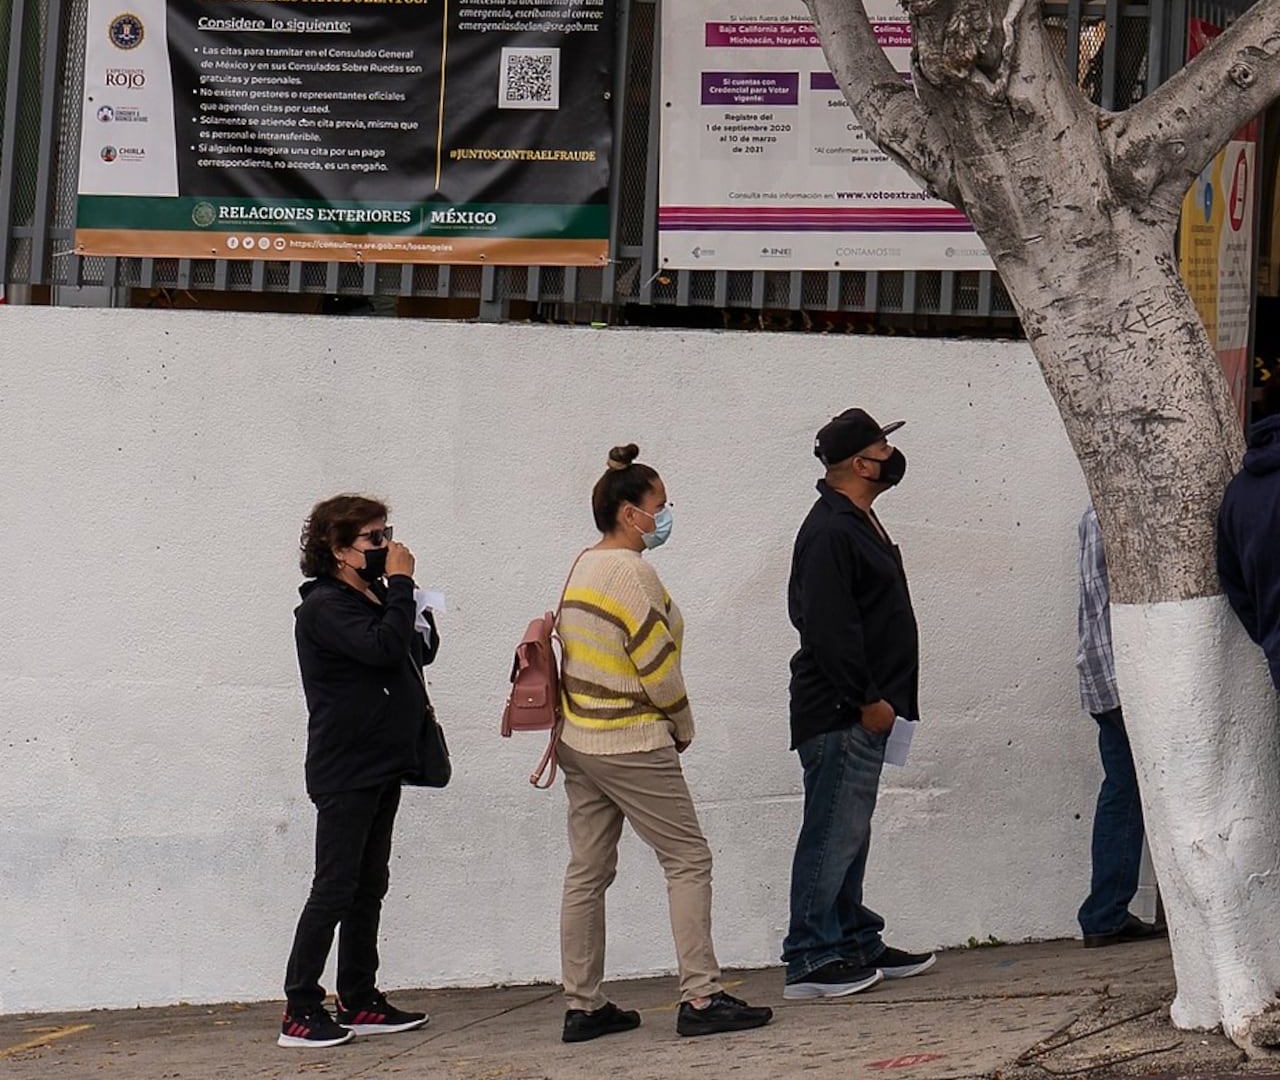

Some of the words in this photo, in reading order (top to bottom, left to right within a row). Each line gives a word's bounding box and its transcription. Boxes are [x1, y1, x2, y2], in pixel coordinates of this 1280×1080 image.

[198, 17, 265, 31] Considere
[272, 18, 284, 31] lo
[286, 18, 351, 33] siguiente:
[203, 46, 219, 55] Las
[220, 46, 242, 55] citas
[266, 48, 303, 56] tramitar
[319, 48, 327, 57] el
[329, 48, 377, 57] Consulado
[378, 49, 414, 58] General
[106, 73, 146, 89] ROJO
[200, 88, 213, 96] No
[214, 88, 248, 97] existen
[250, 90, 290, 99] gestores
[300, 92, 367, 100] representantes
[725, 114, 758, 122] Registro
[450, 149, 596, 161] #JUNTOSCONTRAELFRAUDE
[219, 206, 314, 220] RELACIONES
[318, 208, 411, 224] EXTERIORES
[431, 208, 496, 225] MÉXICO
